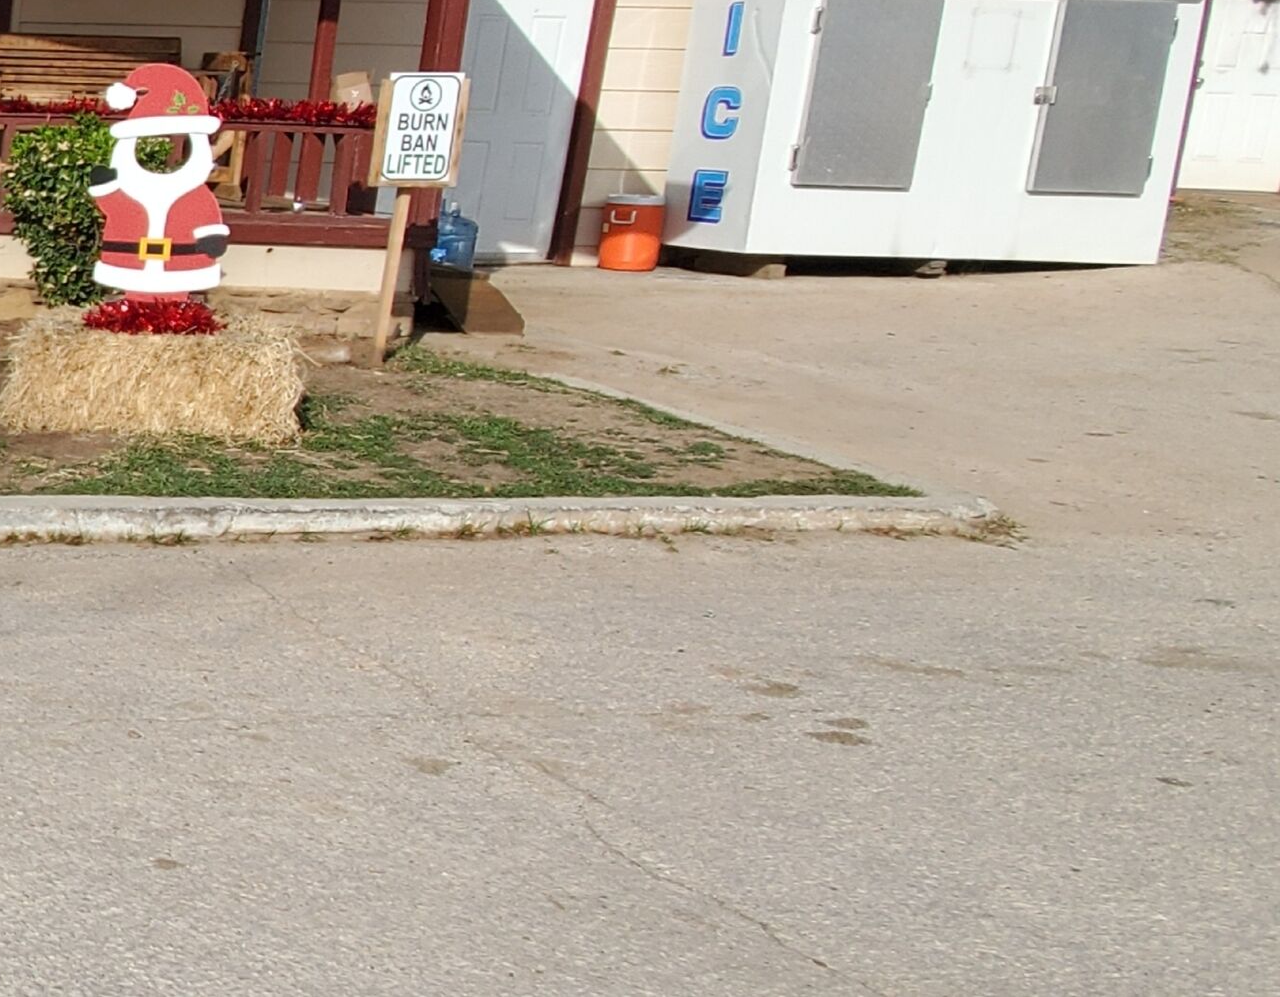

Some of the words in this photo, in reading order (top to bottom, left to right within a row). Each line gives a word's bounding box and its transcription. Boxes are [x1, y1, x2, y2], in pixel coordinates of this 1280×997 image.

[397, 113, 449, 131] BURN
[686, 1, 745, 224] ICE
[400, 134, 438, 152] BAN
[386, 154, 446, 175] LIFTED
